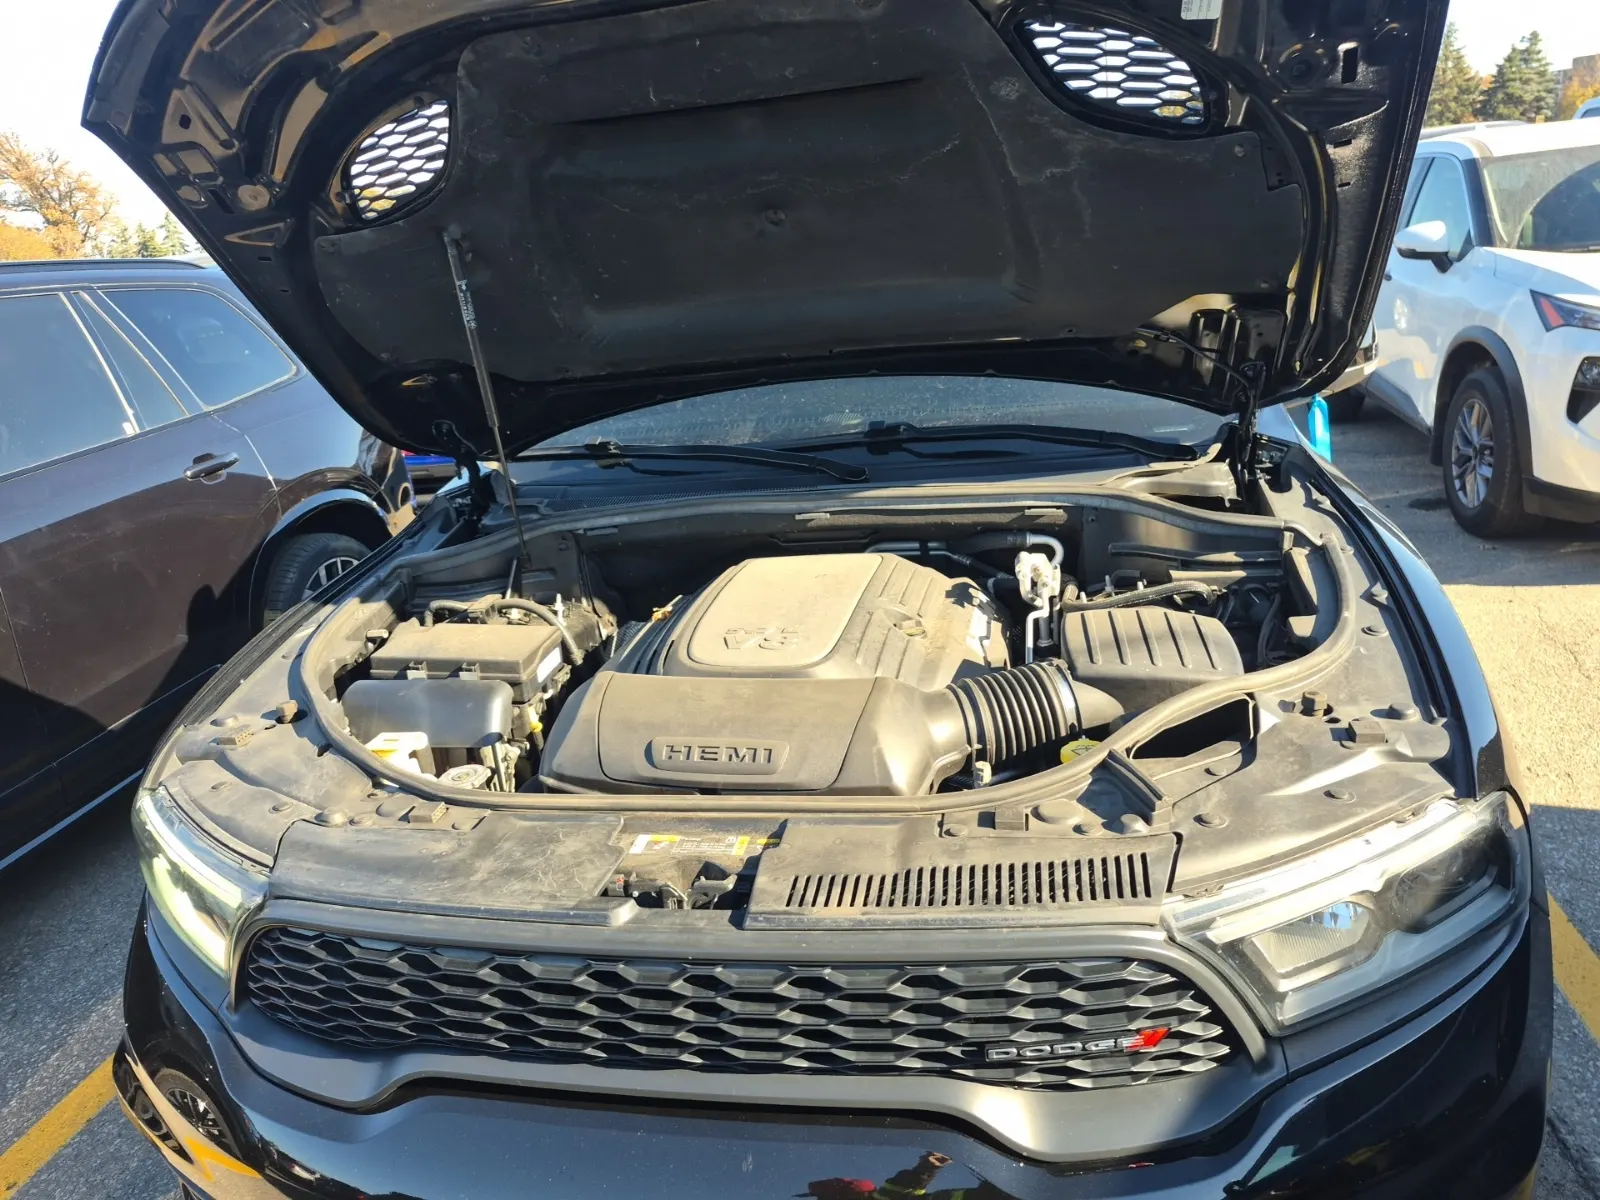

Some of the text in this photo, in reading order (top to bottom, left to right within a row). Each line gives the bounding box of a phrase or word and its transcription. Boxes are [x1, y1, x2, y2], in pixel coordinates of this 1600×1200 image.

[723, 634, 800, 651] V8
[662, 744, 773, 764] HEMI
[987, 1034, 1145, 1061] DODGE
